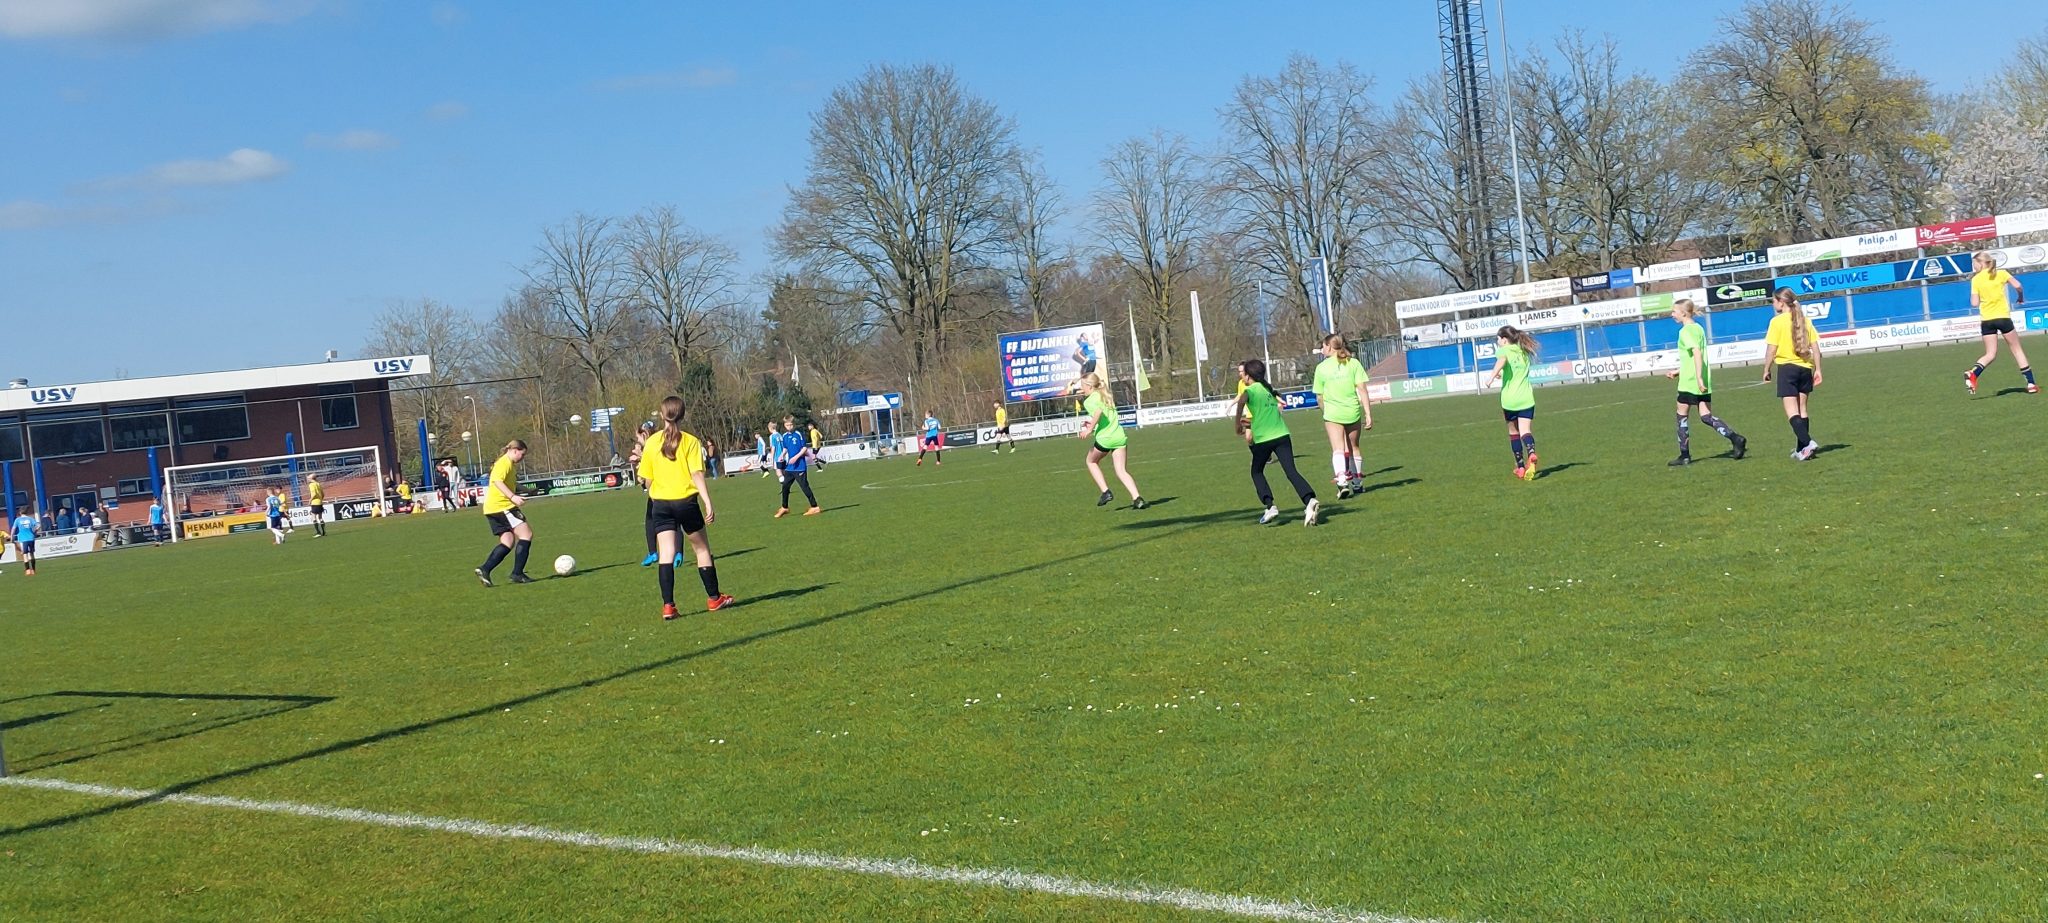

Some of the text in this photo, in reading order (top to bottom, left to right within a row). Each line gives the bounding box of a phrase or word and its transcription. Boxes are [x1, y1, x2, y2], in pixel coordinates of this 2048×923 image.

[1858, 232, 1898, 246] Pintip.nl
[1478, 291, 1500, 303] USV
[1518, 309, 1558, 326] HAMERS
[1591, 307, 1637, 319] BOUWCENTER
[1465, 316, 1509, 331] Bos Bedden
[1869, 328, 1888, 340] Bos
[1890, 324, 1929, 338] Bedden
[1006, 334, 1078, 353] FF BIJTANKEN
[373, 358, 414, 373] USV
[1011, 353, 1061, 367] AAN DE POMP
[1011, 367, 1022, 377] EN
[1023, 366, 1040, 375] OOK
[1574, 359, 1633, 377] Gebotours
[1012, 375, 1050, 387] BROODJES
[1402, 377, 1433, 394] groen
[31, 387, 77, 403] USV
[1285, 394, 1305, 408] Epe
[552, 474, 602, 488] Kitcentrum.nl
[186, 520, 225, 534] HEKMAN
